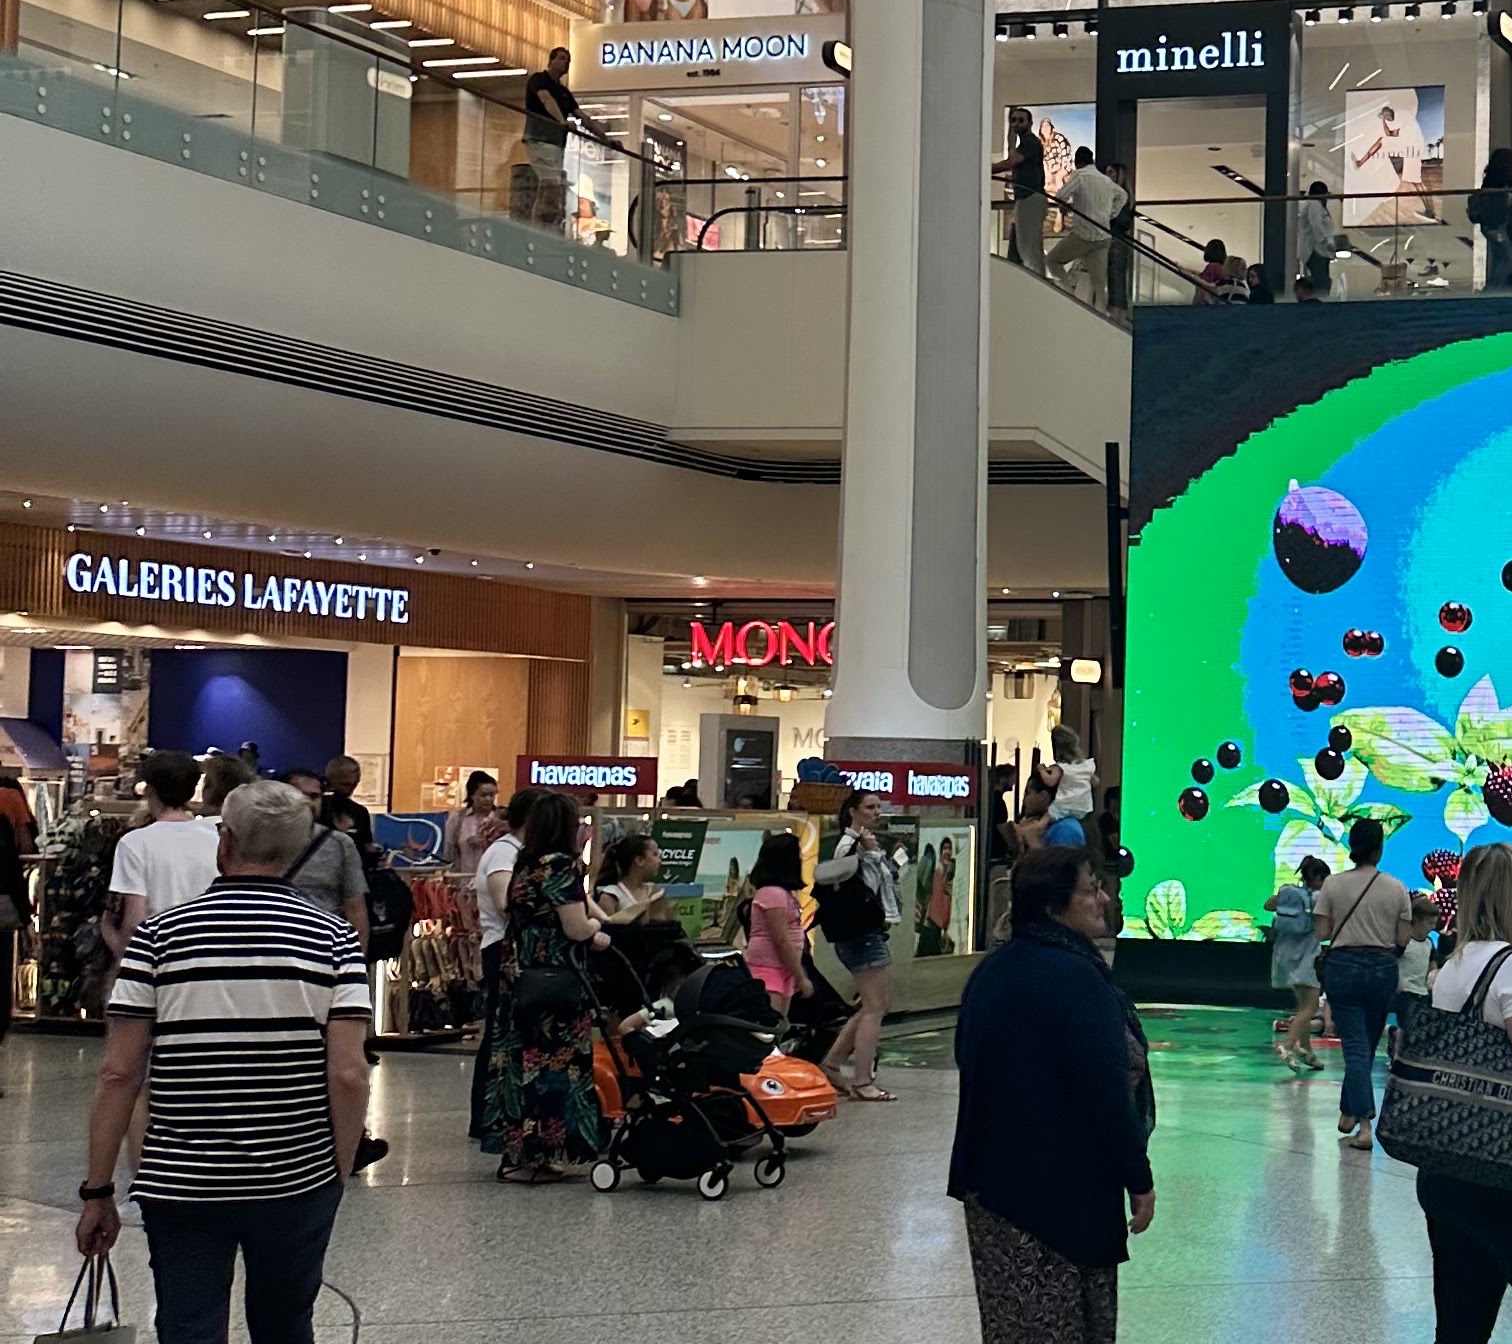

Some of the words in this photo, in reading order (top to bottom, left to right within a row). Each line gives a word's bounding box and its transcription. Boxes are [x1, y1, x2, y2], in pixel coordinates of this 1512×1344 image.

[602, 38, 714, 65] BANANA
[722, 33, 808, 59] MOON
[1116, 30, 1265, 73] minelli
[65, 552, 236, 607] GALERIES
[244, 573, 409, 624] LAFAYETTE
[531, 761, 637, 788] havaianas
[908, 769, 970, 799] havaianas
[1432, 1071, 1494, 1095] CHRISTIAN
